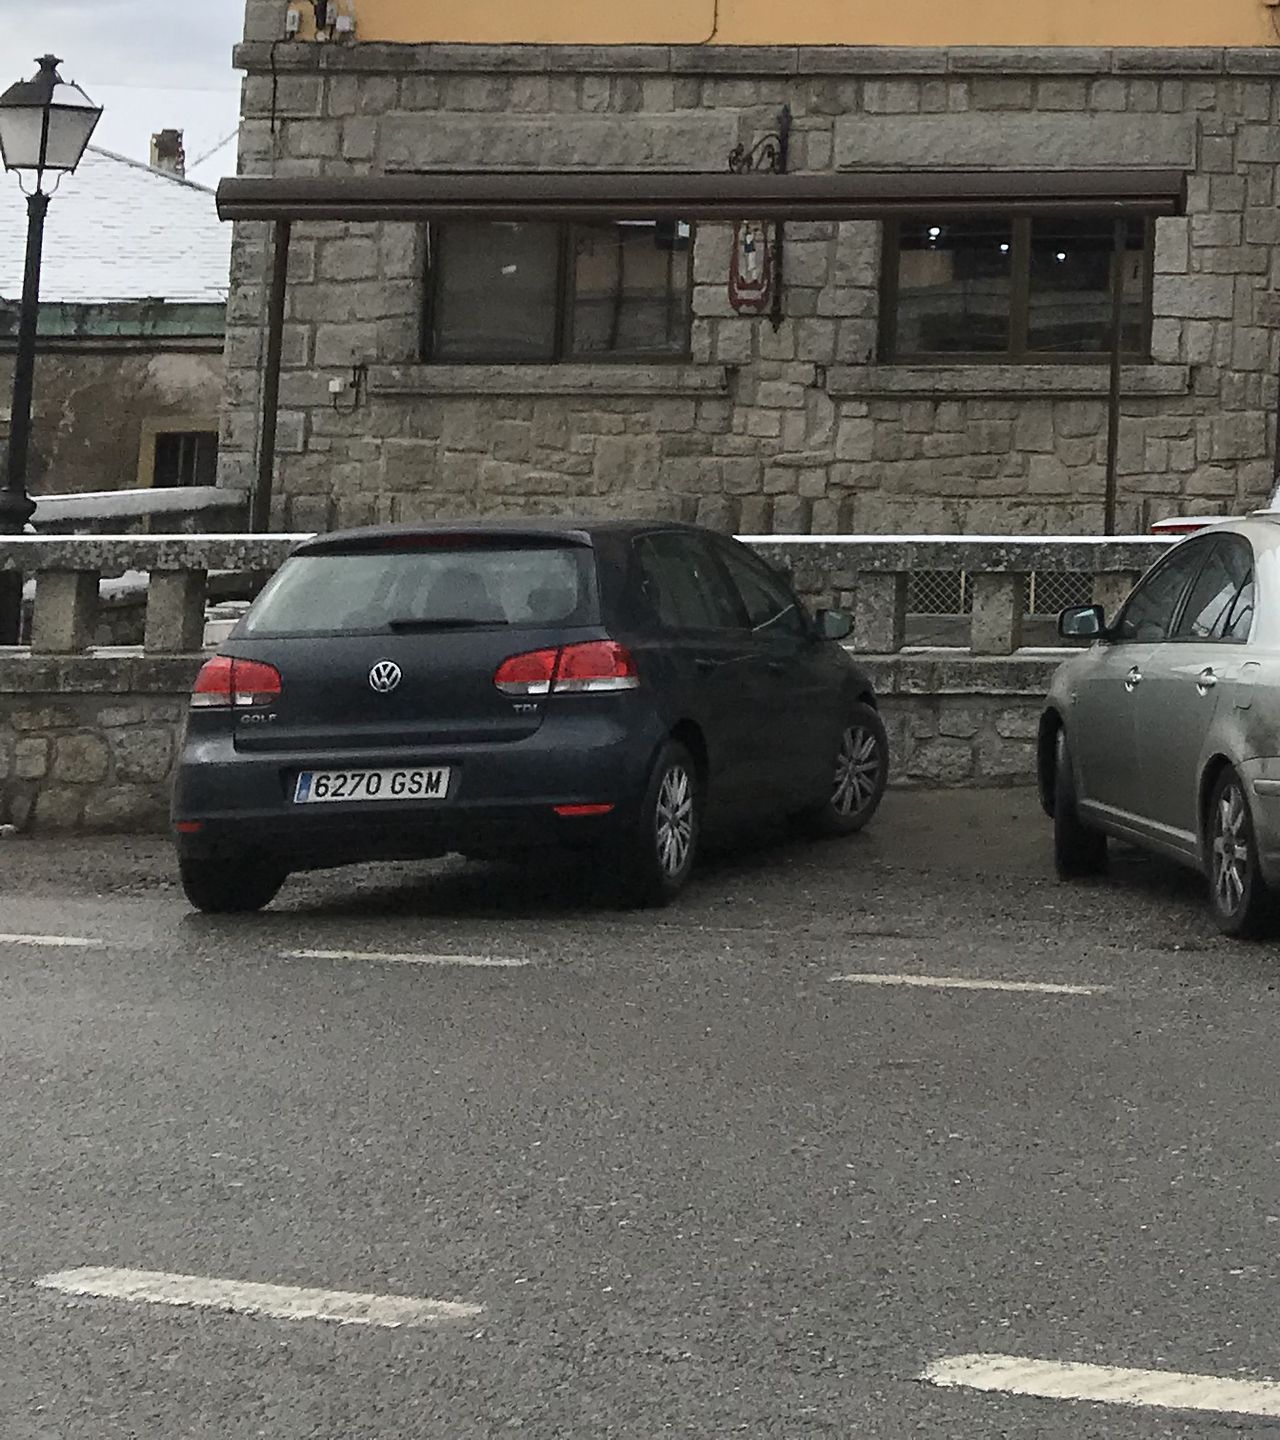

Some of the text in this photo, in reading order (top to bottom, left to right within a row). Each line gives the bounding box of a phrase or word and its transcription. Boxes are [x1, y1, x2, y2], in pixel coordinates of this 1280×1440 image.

[240, 713, 278, 724] GOLF
[314, 770, 444, 798] 6270 GSM
